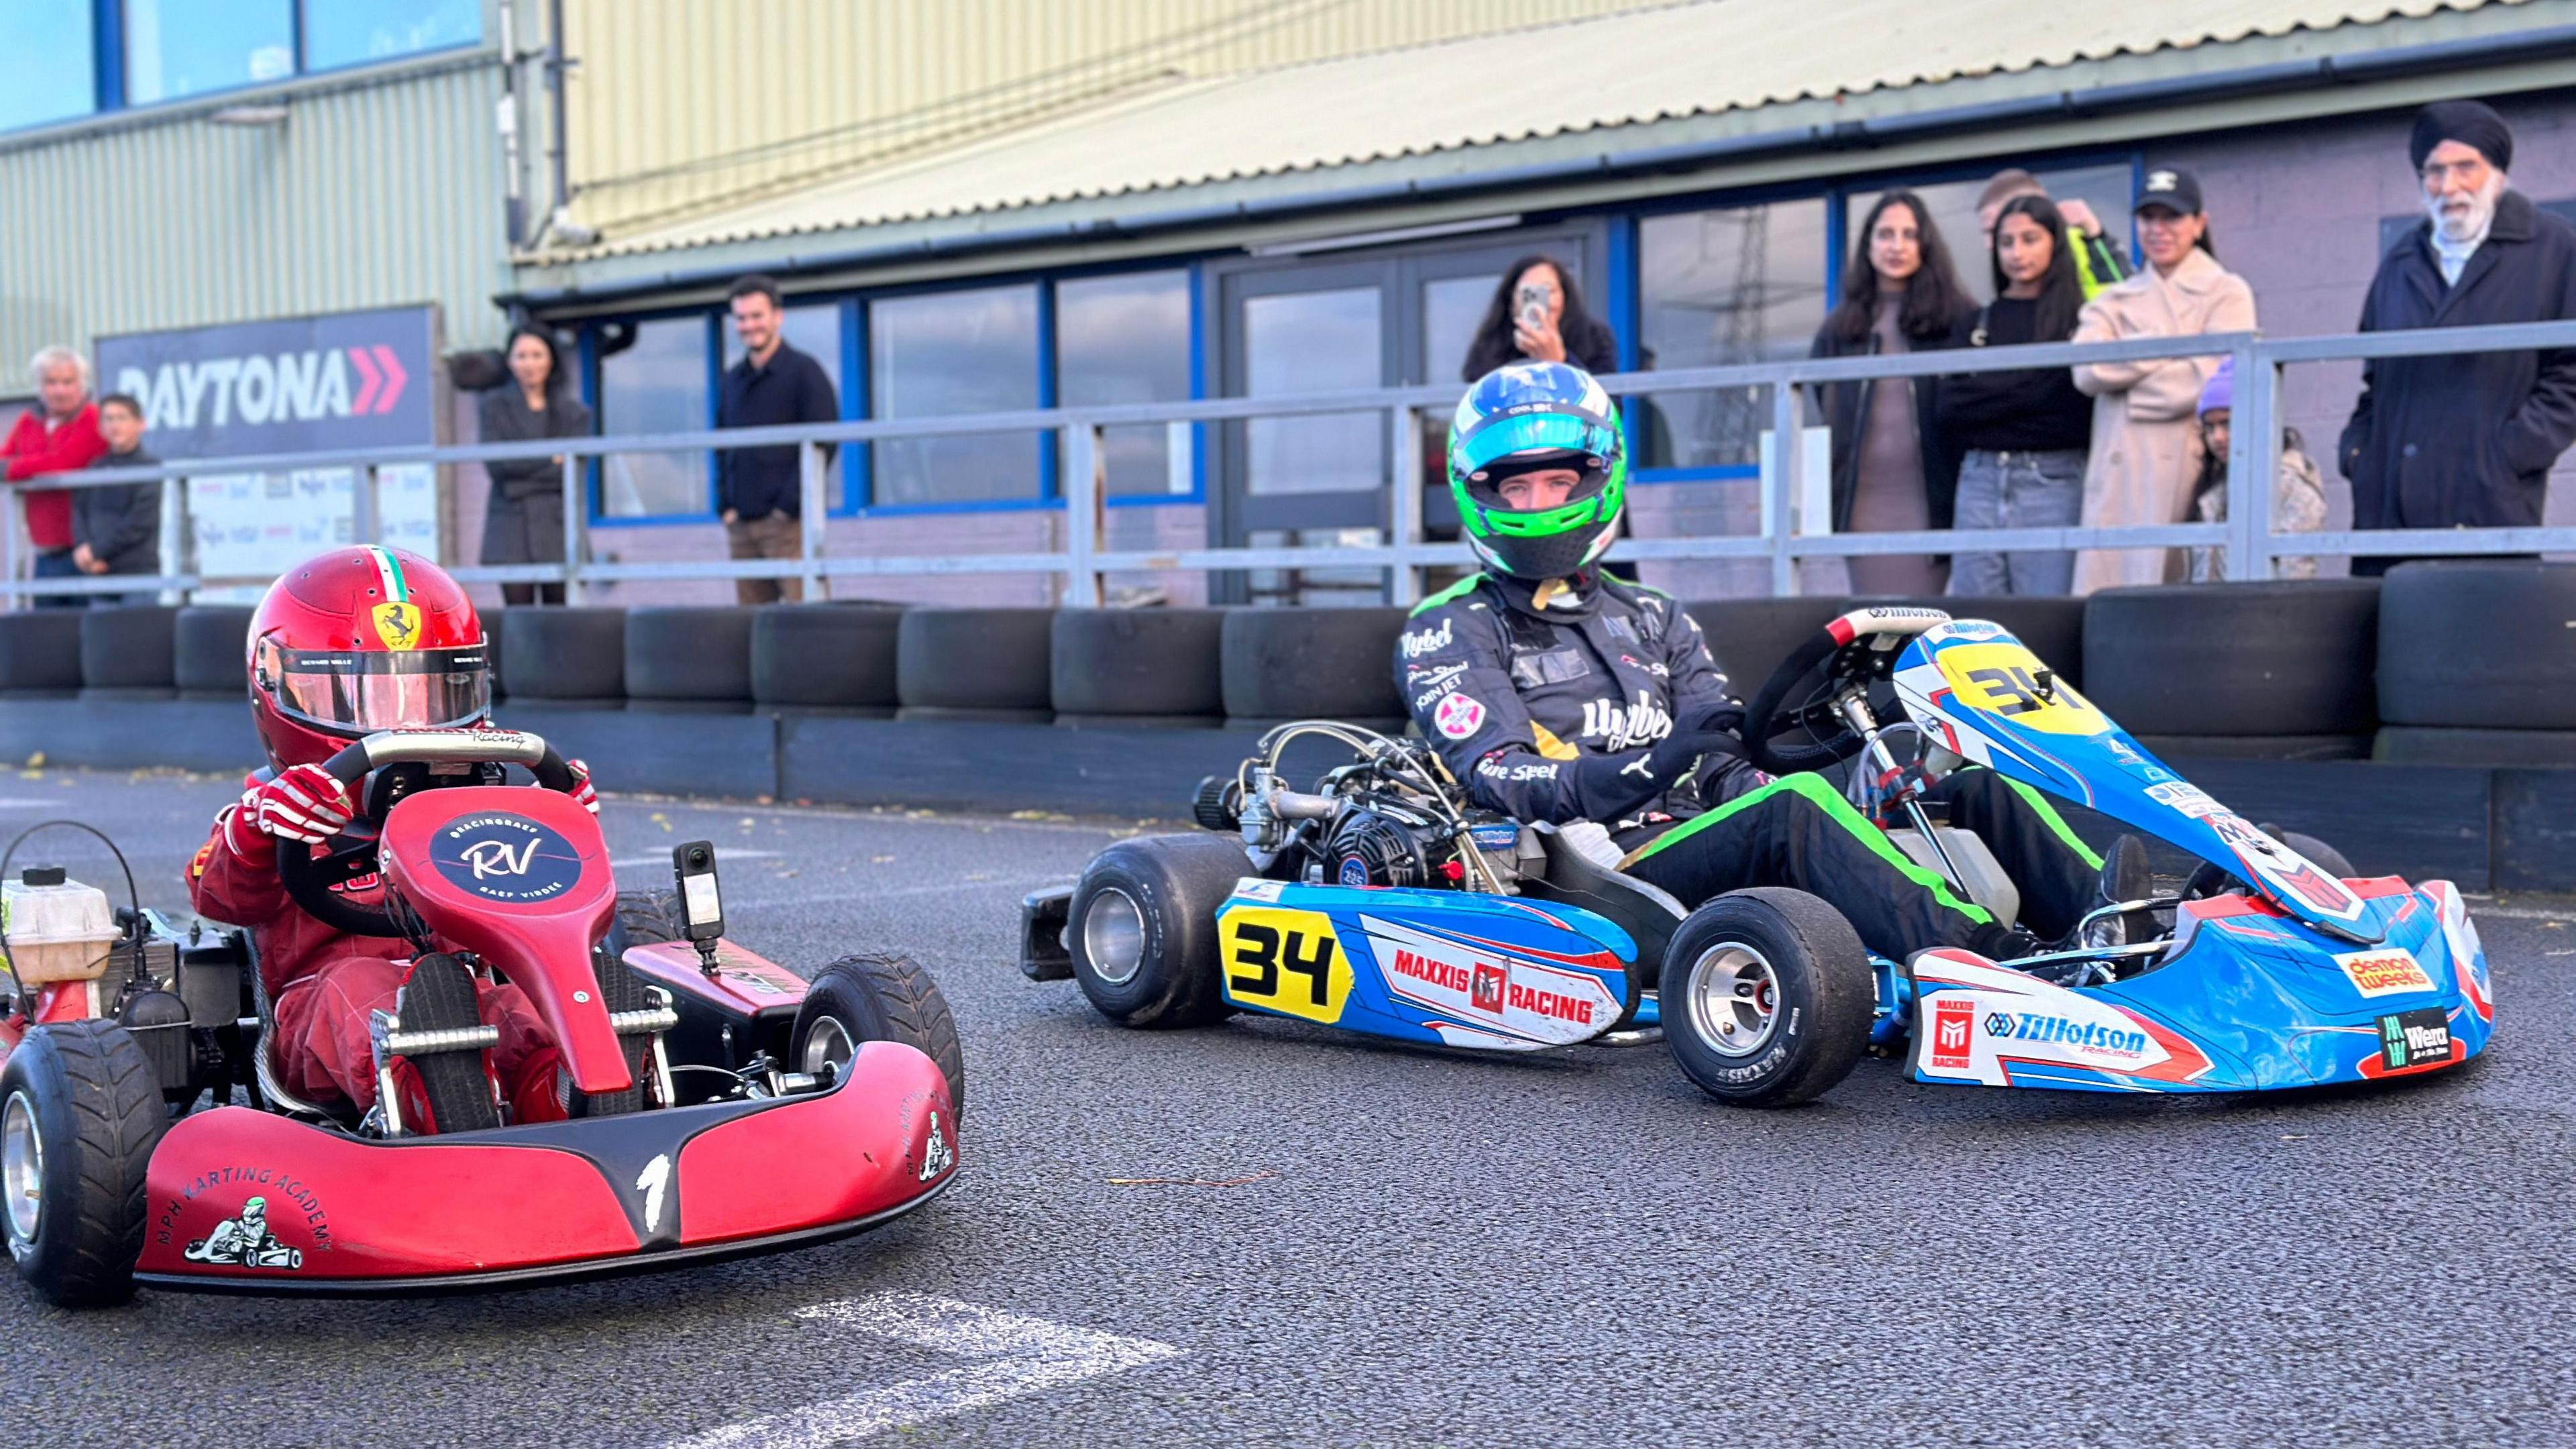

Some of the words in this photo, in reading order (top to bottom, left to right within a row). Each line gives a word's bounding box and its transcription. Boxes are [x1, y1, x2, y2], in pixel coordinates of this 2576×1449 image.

[118, 347, 352, 431] DAYTONA
[460, 838, 542, 880] RV
[1231, 922, 1335, 1006] 34
[1393, 949, 1470, 993] MAXXIS
[2349, 957, 2415, 974] demon
[2355, 971, 2428, 990] tweeks
[1509, 983, 1595, 1025] RACING
[2013, 1013, 2146, 1053] Tillotson
[2080, 1046, 2142, 1059] RACING
[2405, 1026, 2449, 1050] Wera
[157, 1199, 182, 1246] MPH
[182, 1167, 274, 1201] KARTING
[274, 1175, 333, 1252] ACADEMY
[636, 1154, 670, 1232] 1
